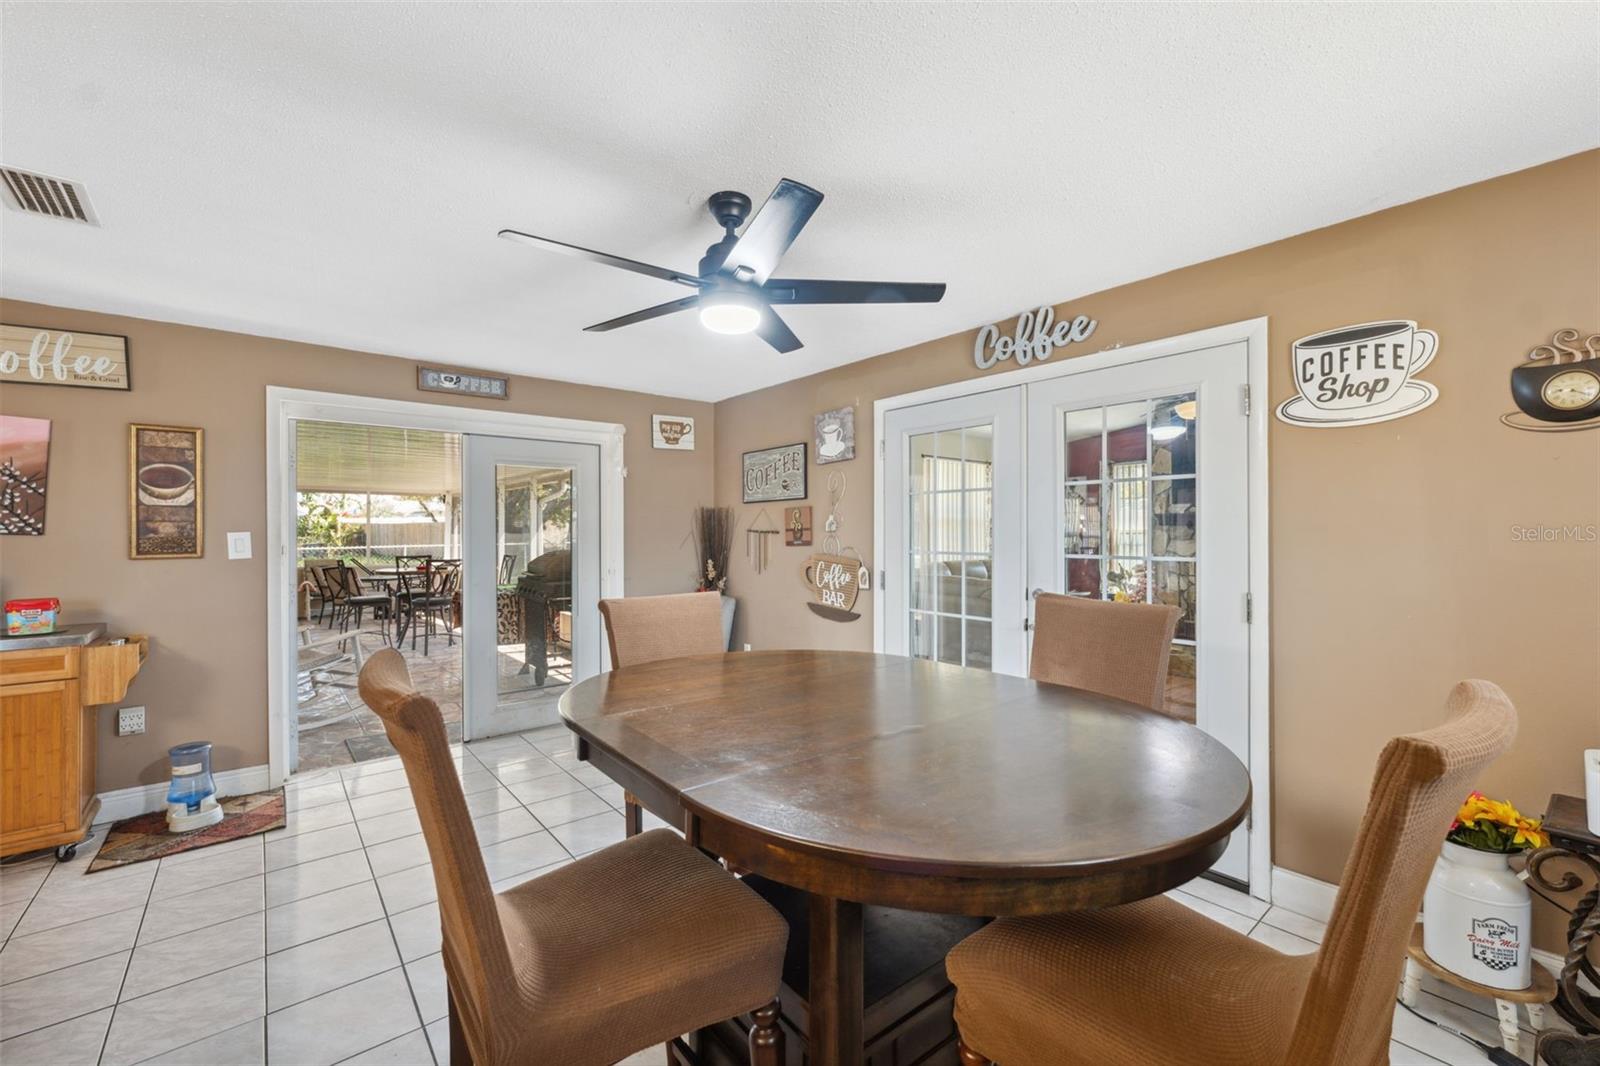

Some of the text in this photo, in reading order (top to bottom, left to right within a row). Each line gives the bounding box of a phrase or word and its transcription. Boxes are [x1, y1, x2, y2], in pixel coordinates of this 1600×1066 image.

[974, 305, 1098, 369] Coffee
[0, 332, 118, 381] offee
[1302, 343, 1405, 383] COFFEE
[427, 372, 502, 395] CFFEE
[1316, 373, 1390, 403] Shop
[746, 451, 800, 492] COFFEE
[816, 561, 852, 590] Coffee
[822, 589, 845, 608] BAR
[1467, 934, 1520, 949] Dairy Milk
